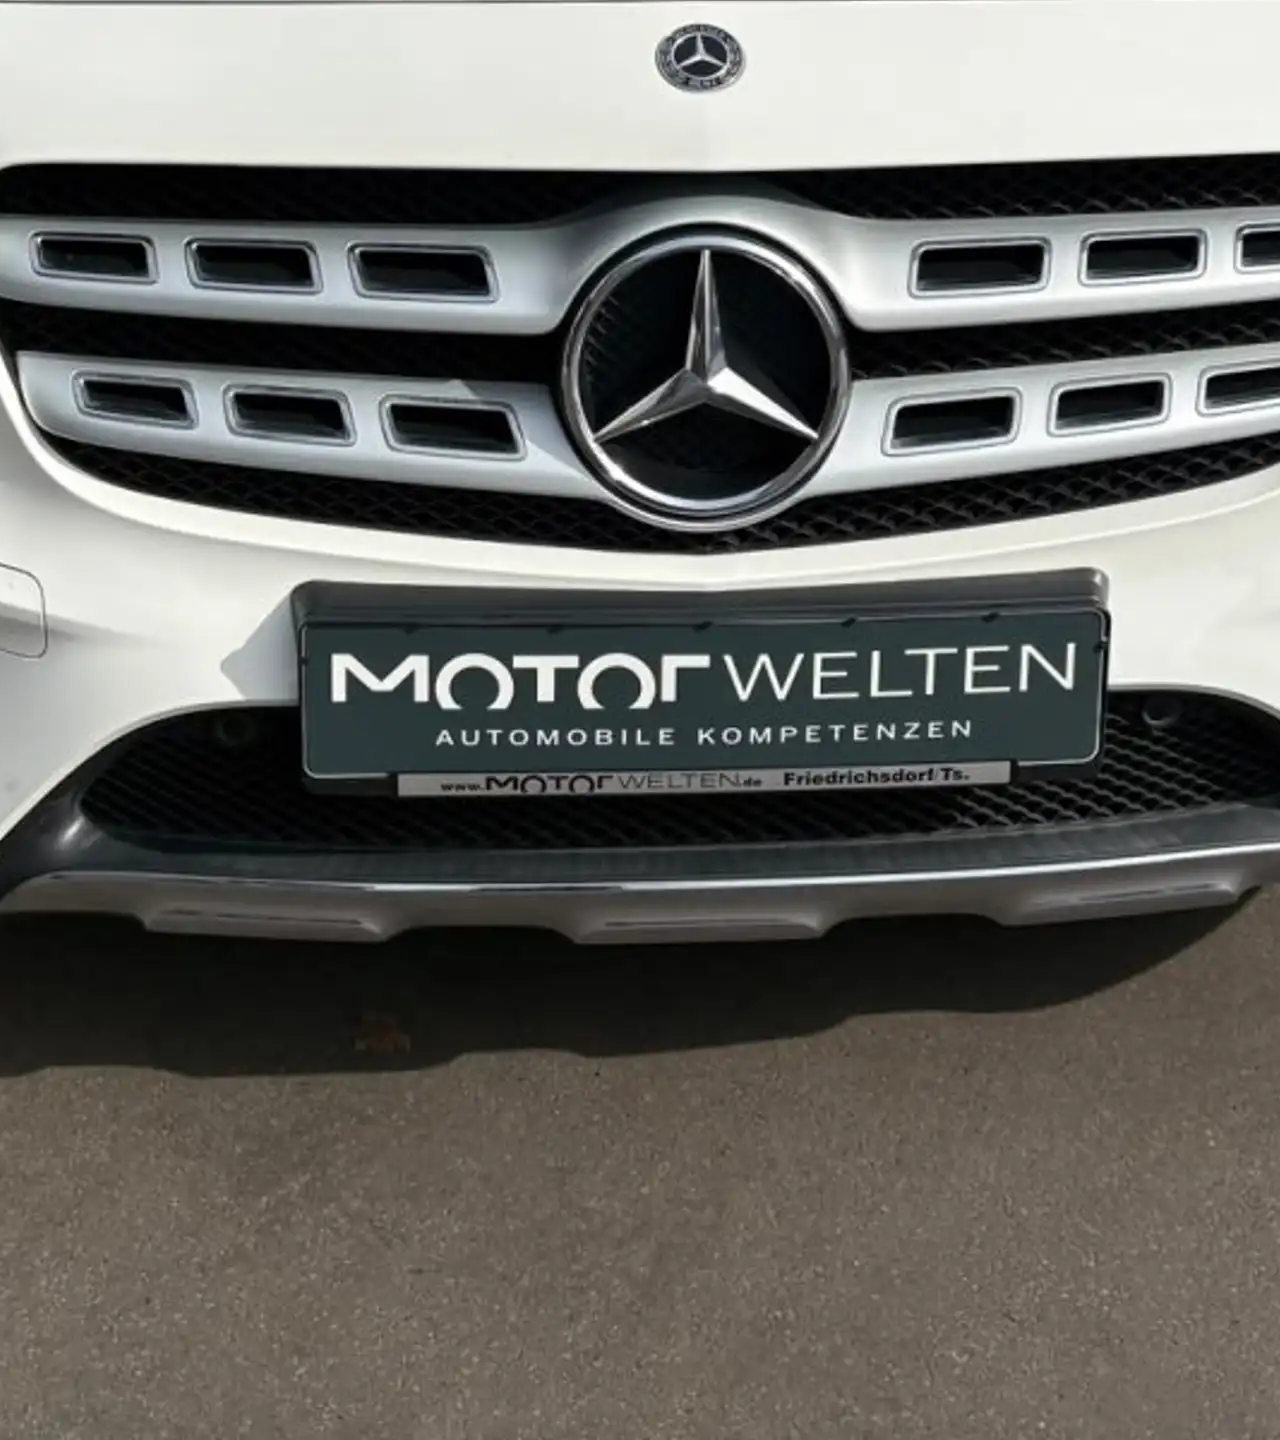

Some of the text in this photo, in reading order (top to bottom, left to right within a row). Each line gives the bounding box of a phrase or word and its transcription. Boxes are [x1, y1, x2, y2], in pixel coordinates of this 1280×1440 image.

[435, 719, 973, 747] AUTOMOBILE KOMPETENZEN
[782, 767, 935, 788] Friedrichsdorf
[939, 766, 971, 783] Ts.
